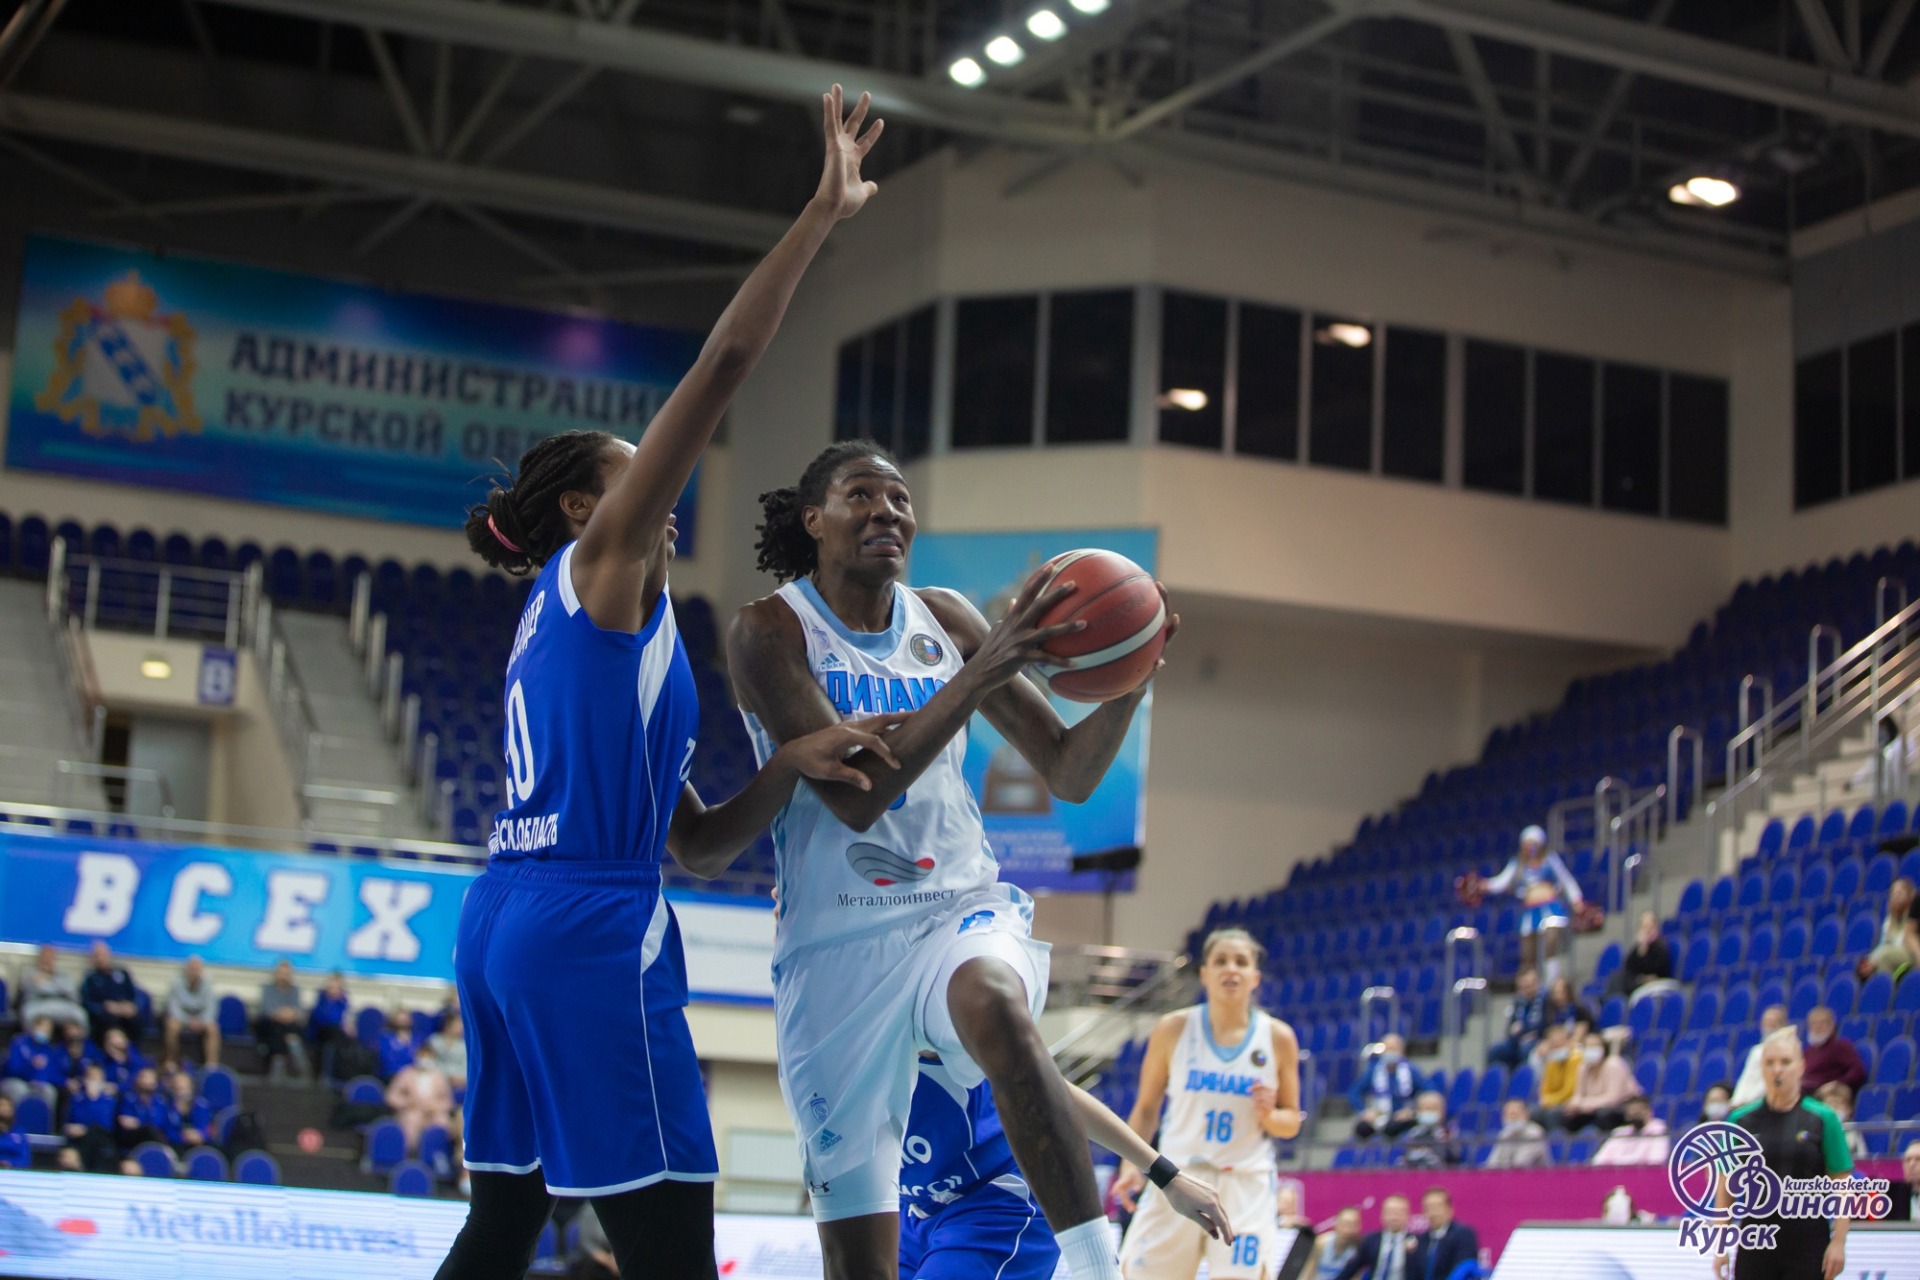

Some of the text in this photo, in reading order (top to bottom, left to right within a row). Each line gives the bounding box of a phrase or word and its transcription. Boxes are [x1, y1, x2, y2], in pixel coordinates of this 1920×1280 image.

[229, 333, 664, 427] АДМИНИСТРАЦИ
[223, 389, 444, 457] КУРСКОЙ
[63, 851, 433, 962] ВСЕХ
[837, 889, 957, 907] Металлоинвест
[1185, 1069, 1263, 1096] ДИНАМ
[1204, 1109, 1235, 1143] 16
[1232, 1233, 1259, 1266] 16
